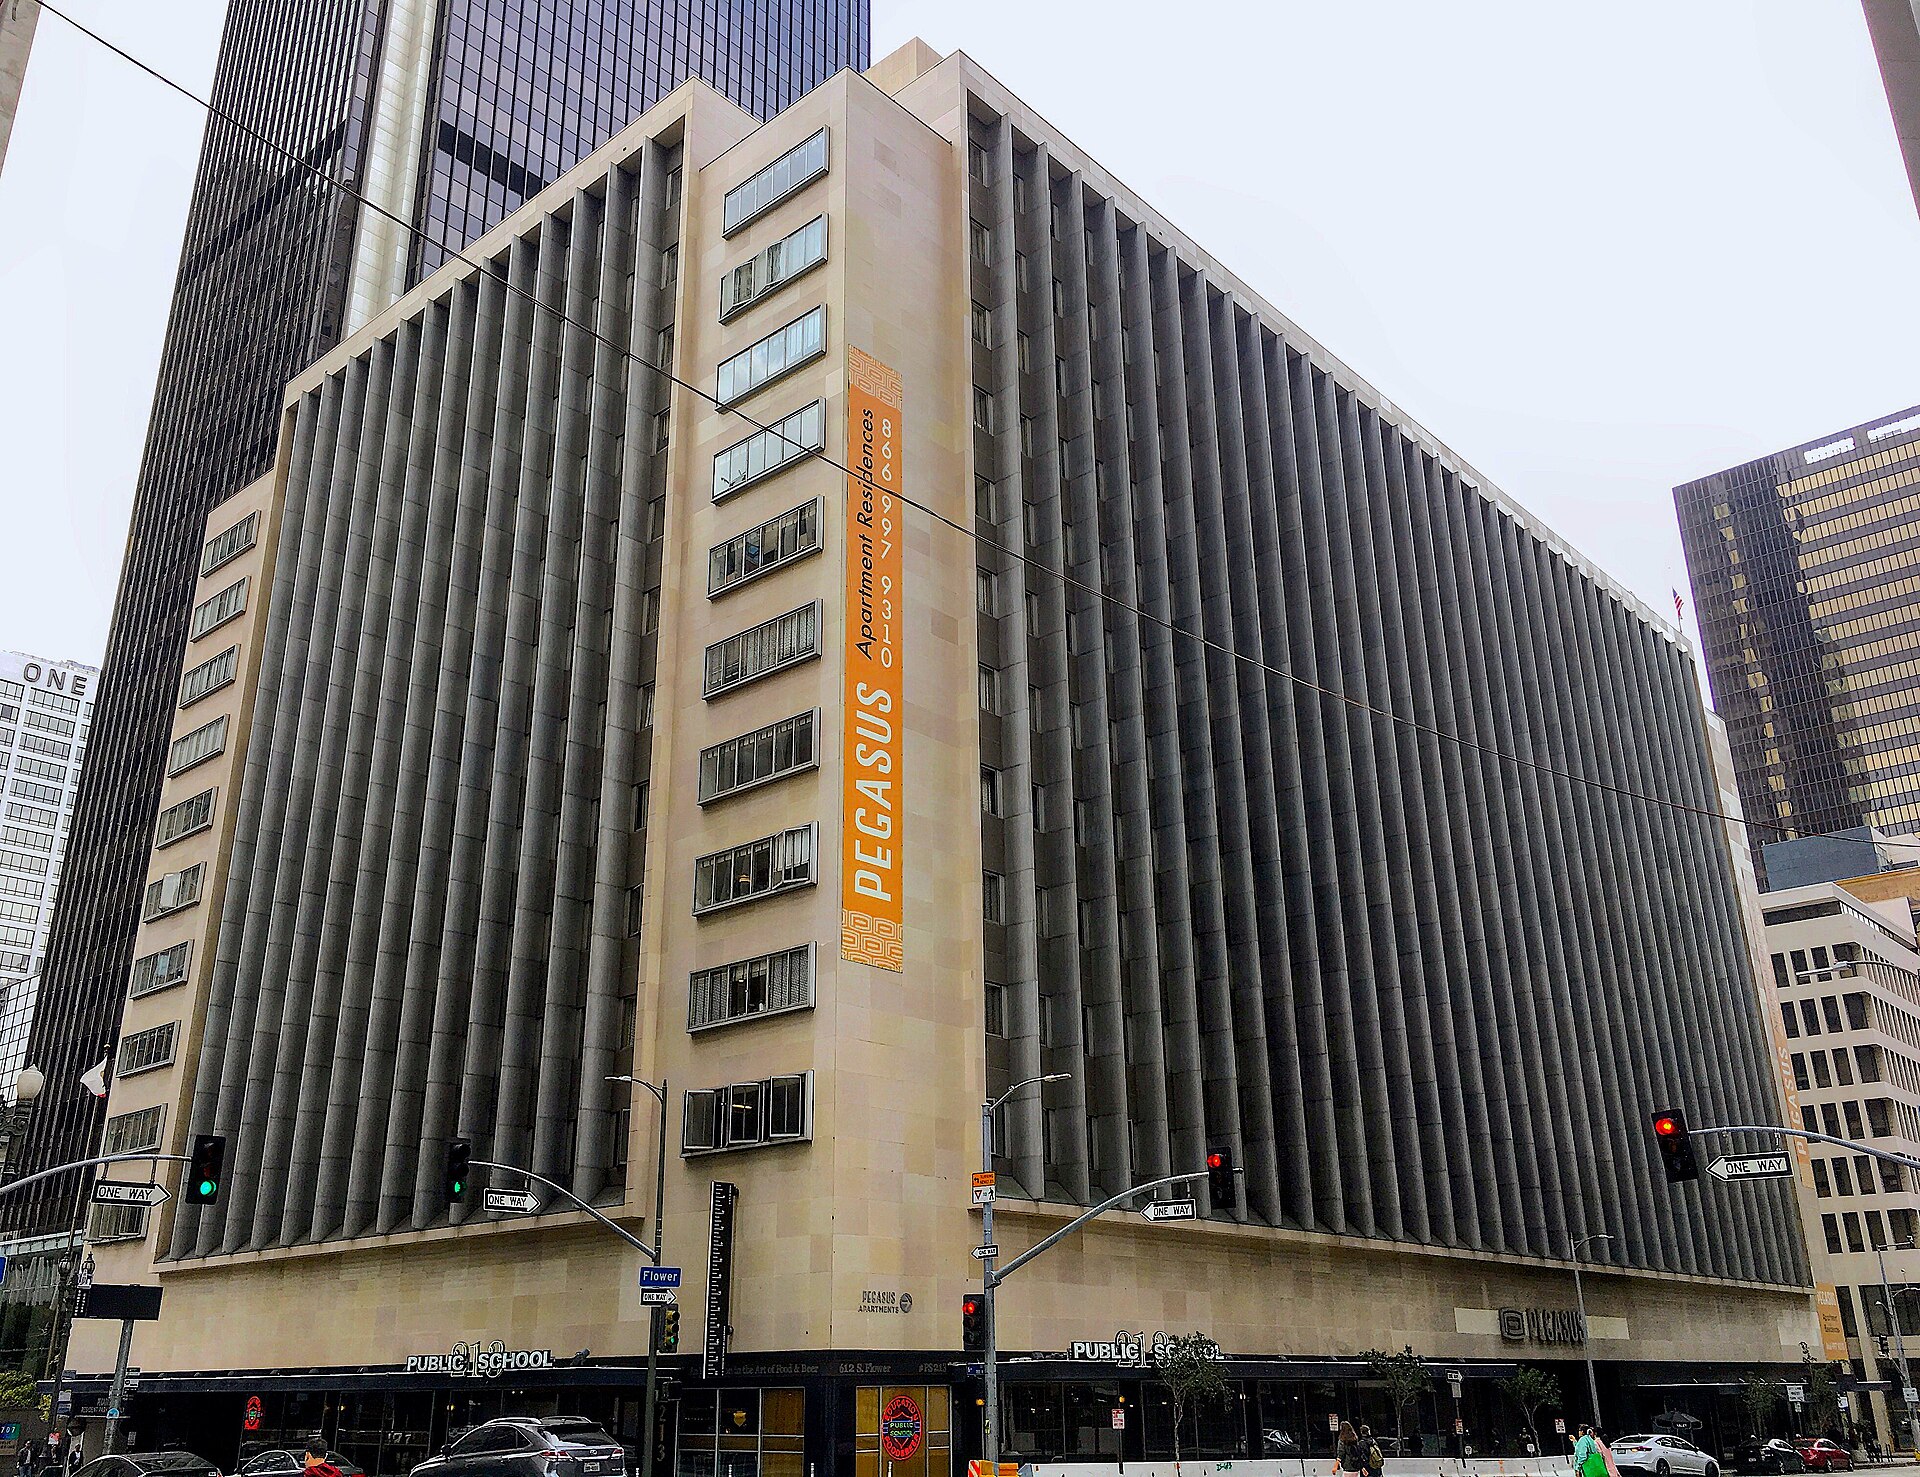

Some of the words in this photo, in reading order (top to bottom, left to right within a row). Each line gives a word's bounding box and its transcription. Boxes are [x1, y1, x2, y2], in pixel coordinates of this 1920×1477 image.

[881, 418, 893, 483] 866
[856, 408, 875, 530] Residences
[880, 494, 893, 560] 997
[856, 533, 875, 661] Apartment
[880, 575, 893, 669] 9310
[23, 662, 88, 697] ONE
[854, 681, 893, 903] PEGASUS
[1778, 1046, 1807, 1157] PGASUS
[1725, 1162, 1751, 1174] ONE
[1757, 1159, 1782, 1171] WAY
[98, 1187, 122, 1198] ONE
[128, 1188, 153, 1200] WAY
[488, 1194, 505, 1205] ONE
[510, 1196, 527, 1206] WAY
[1153, 1207, 1169, 1216] ONE
[1173, 1205, 1190, 1215] WAY
[643, 1270, 678, 1282] Flower
[644, 1293, 655, 1301] ONE
[862, 1290, 896, 1305] PEGASUS
[858, 1304, 900, 1314] APARTMENTS
[450, 1339, 506, 1378] 213
[1073, 1342, 1139, 1360] PUBLIC
[406, 1355, 465, 1372] PUBLIC
[477, 1350, 554, 1370] SCHOOL
[838, 1363, 855, 1374] 612
[865, 1362, 892, 1373] Flower
[0, 1426, 16, 1434] 707
